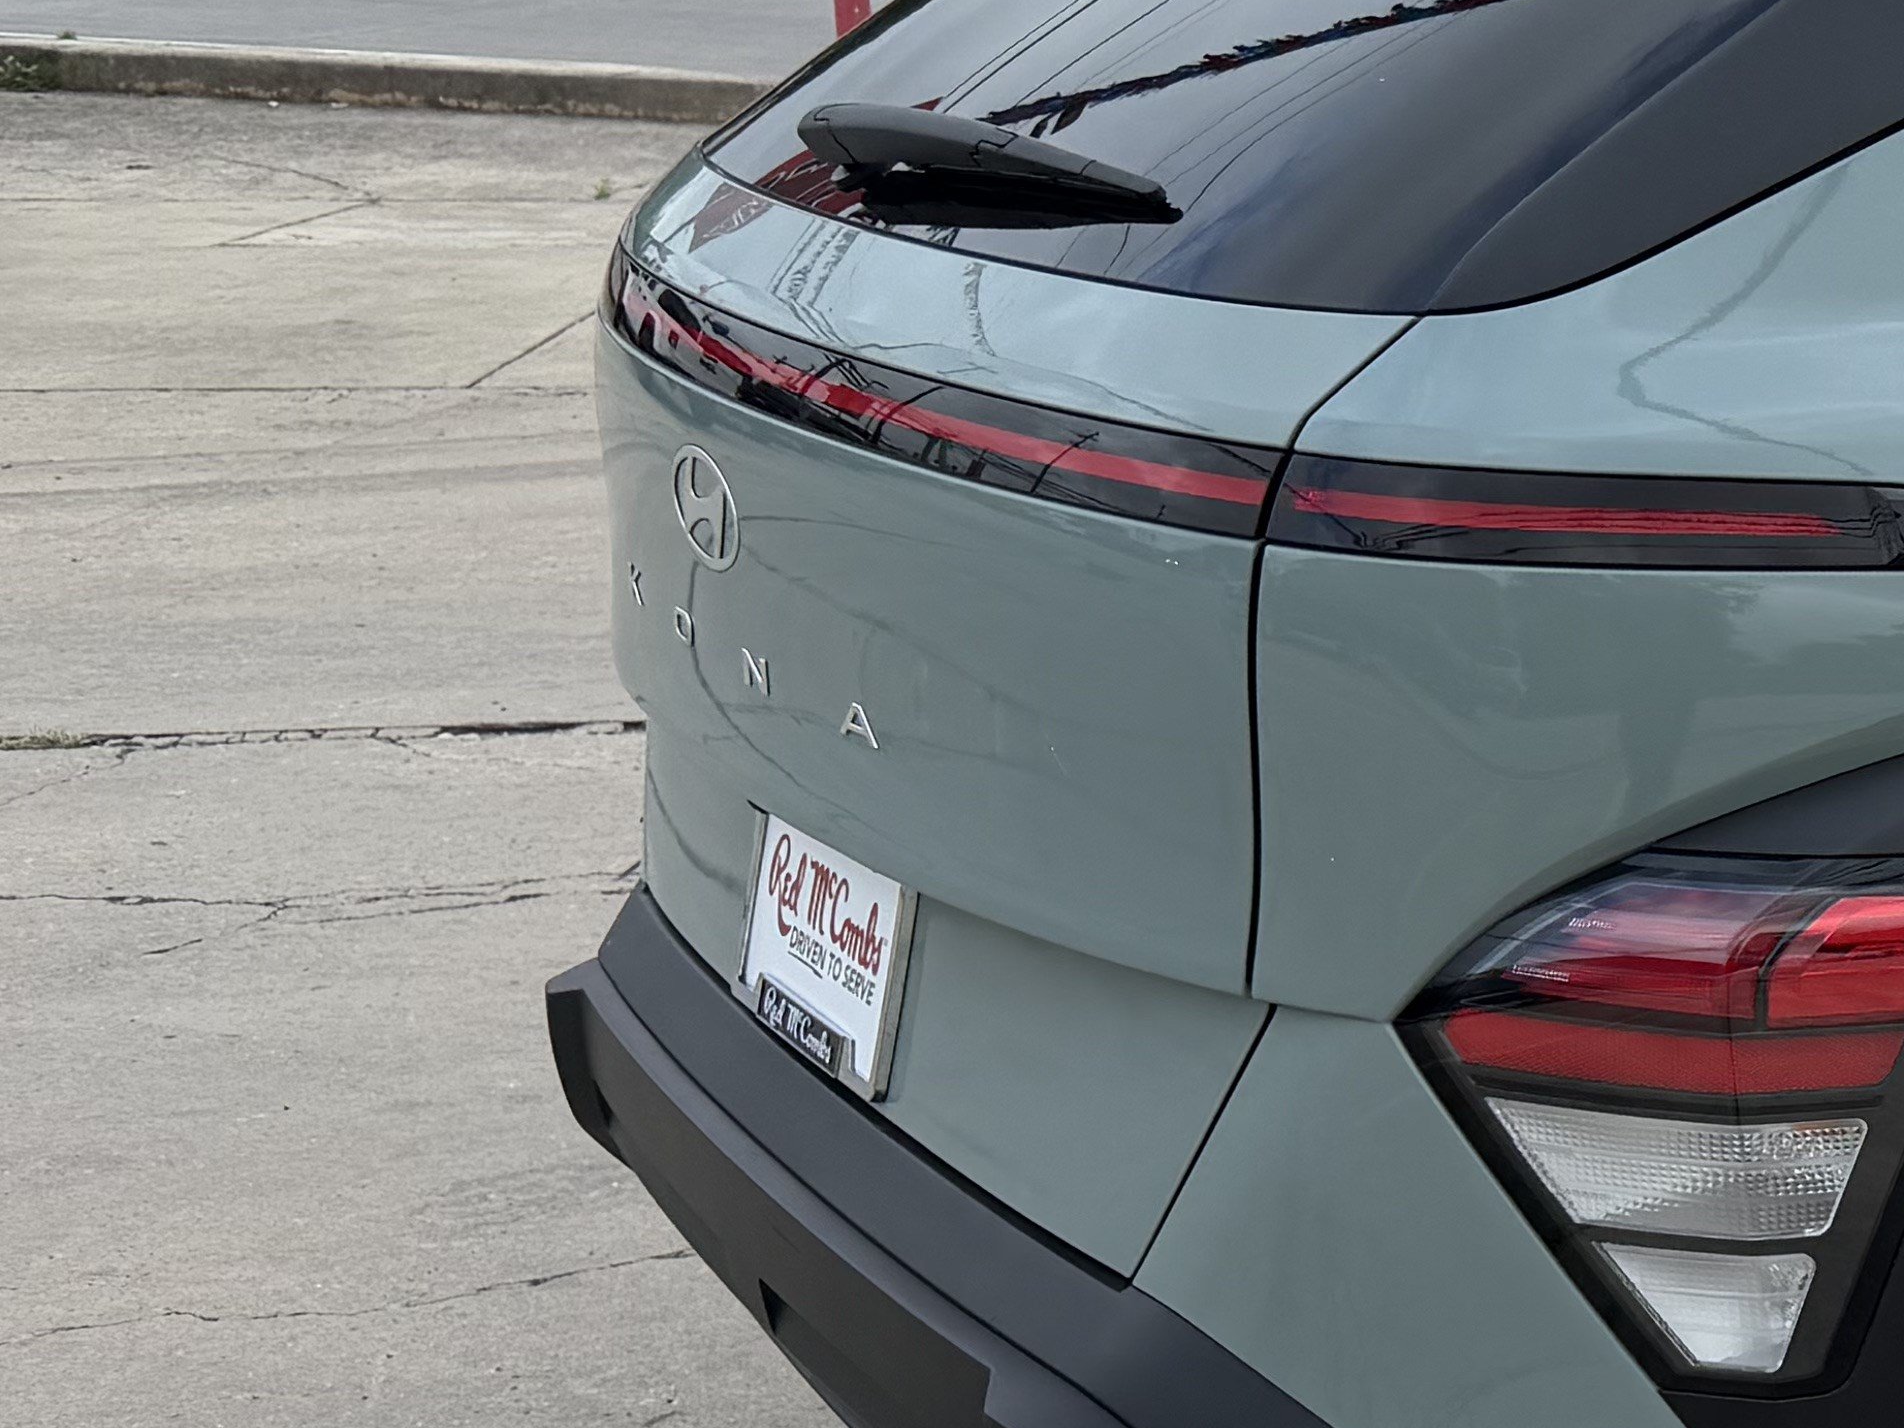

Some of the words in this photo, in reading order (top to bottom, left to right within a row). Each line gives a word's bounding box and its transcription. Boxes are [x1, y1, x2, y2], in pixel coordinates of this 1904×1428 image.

[627, 560, 880, 750] KONA
[768, 833, 809, 937] Red
[808, 859, 884, 977] McCombs
[789, 925, 826, 970] DRIVEN
[827, 952, 841, 983] TO
[842, 965, 877, 1007] SERVE
